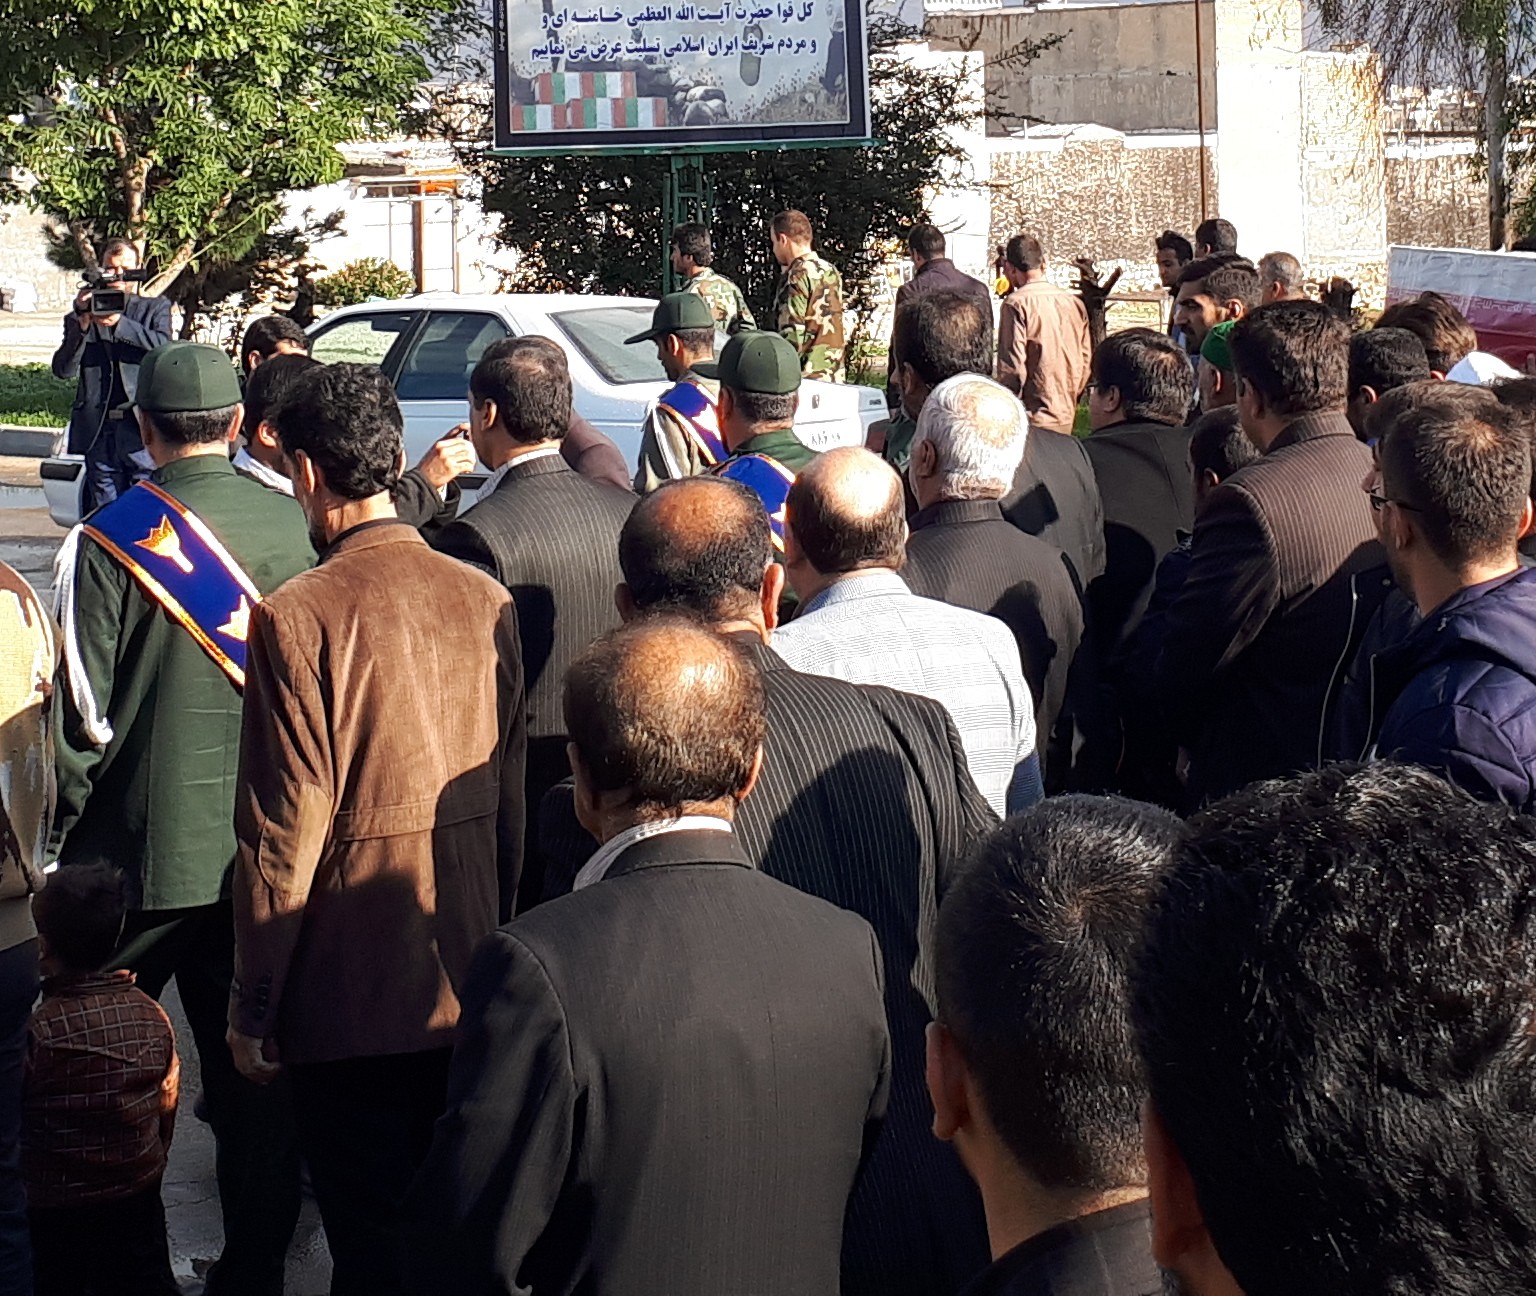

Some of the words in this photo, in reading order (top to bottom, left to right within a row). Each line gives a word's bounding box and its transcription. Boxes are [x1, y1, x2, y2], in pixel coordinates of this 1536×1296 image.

[627, 6, 671, 27] العظمی
[675, 1, 694, 20] الله
[735, 4, 773, 24] حضرت
[777, 1, 793, 23] قوا
[797, 2, 814, 21] کل
[569, 44, 587, 60] می
[590, 39, 622, 60] عرض
[626, 37, 660, 56] تسلیت
[664, 36, 704, 57] اسلامی
[708, 36, 738, 57] ایران
[742, 35, 774, 55] شریف
[777, 37, 806, 54] مردم
[810, 40, 817, 54] و
